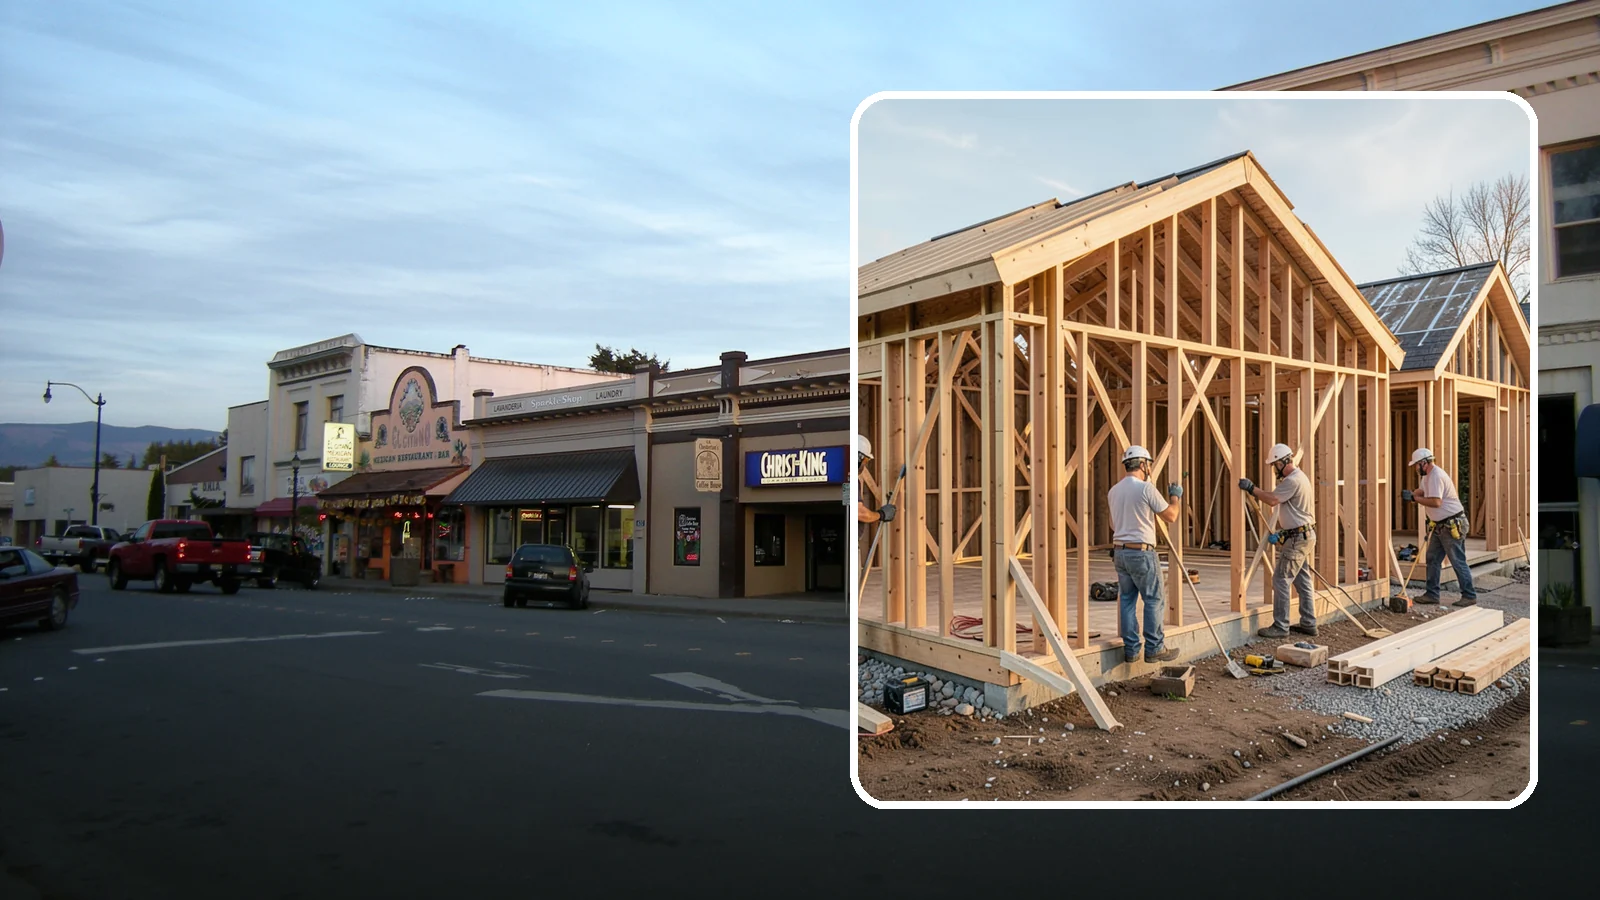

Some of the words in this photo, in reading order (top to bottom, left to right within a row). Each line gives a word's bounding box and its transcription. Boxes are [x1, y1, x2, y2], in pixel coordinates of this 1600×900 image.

[595, 388, 624, 400] LAUNDRY
[493, 401, 523, 413] LAVANDERIA
[530, 396, 560, 409] Sparkle
[561, 394, 582, 404] Shop
[374, 454, 396, 464] MEXICAN
[397, 451, 433, 462] RESTAURANT
[438, 450, 450, 459] BAR
[760, 452, 797, 478] CHRIST
[799, 450, 827, 476] KING
